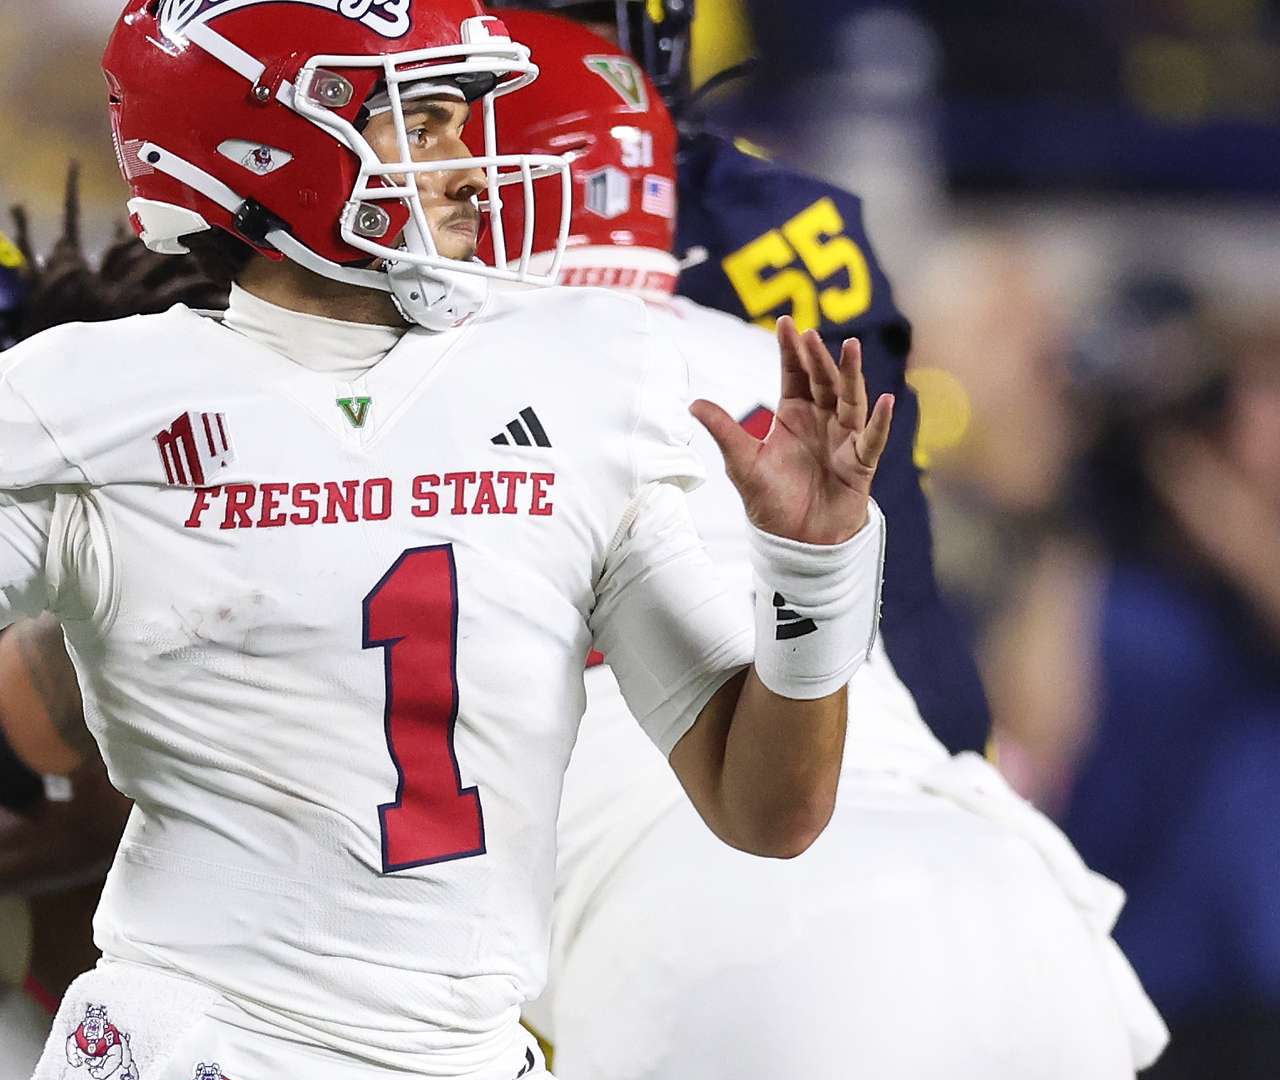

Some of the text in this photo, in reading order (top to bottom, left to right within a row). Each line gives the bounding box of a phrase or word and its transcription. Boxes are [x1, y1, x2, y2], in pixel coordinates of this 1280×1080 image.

[721, 196, 872, 336] 55
[335, 396, 371, 429] V
[184, 470, 555, 530] FRESNO STATE
[362, 543, 487, 873] 1
